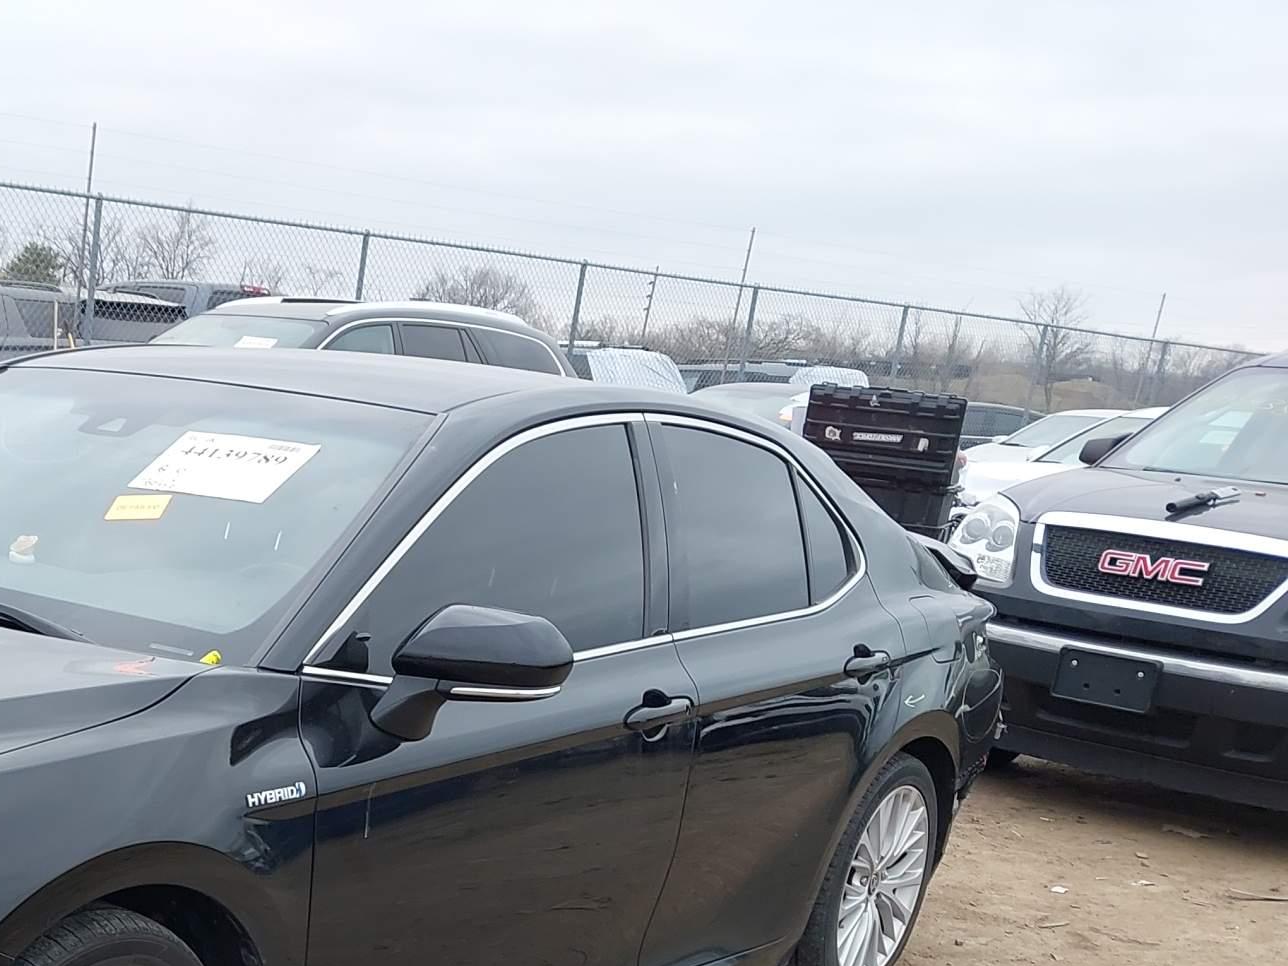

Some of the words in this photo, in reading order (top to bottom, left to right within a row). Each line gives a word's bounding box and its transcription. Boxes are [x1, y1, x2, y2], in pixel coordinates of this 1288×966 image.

[181, 445, 289, 466] 44139789
[1098, 549, 1210, 586] GMC
[246, 785, 297, 808] HYBRID
